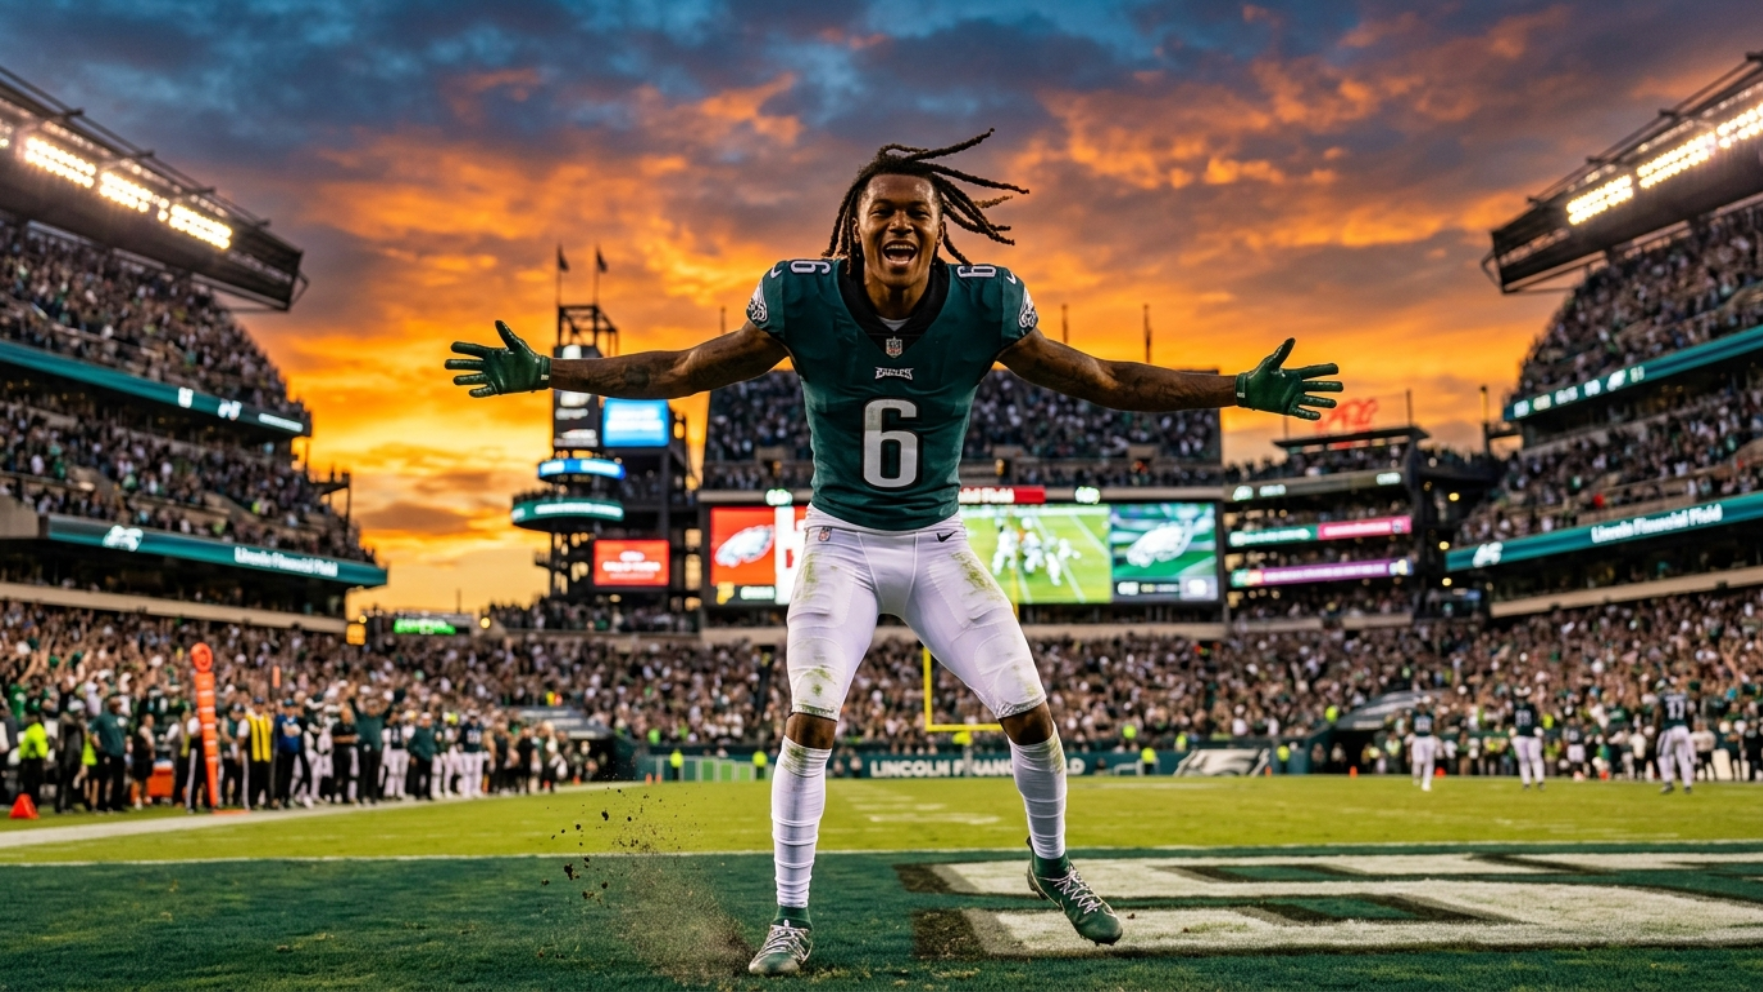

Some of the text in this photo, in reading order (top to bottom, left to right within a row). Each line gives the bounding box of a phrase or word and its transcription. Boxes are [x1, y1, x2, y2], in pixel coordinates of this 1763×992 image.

[790, 260, 831, 275] 6
[957, 264, 997, 278] 6
[874, 366, 914, 380] EAGLES
[862, 397, 921, 490] 6
[869, 759, 951, 777] LINCOLN
